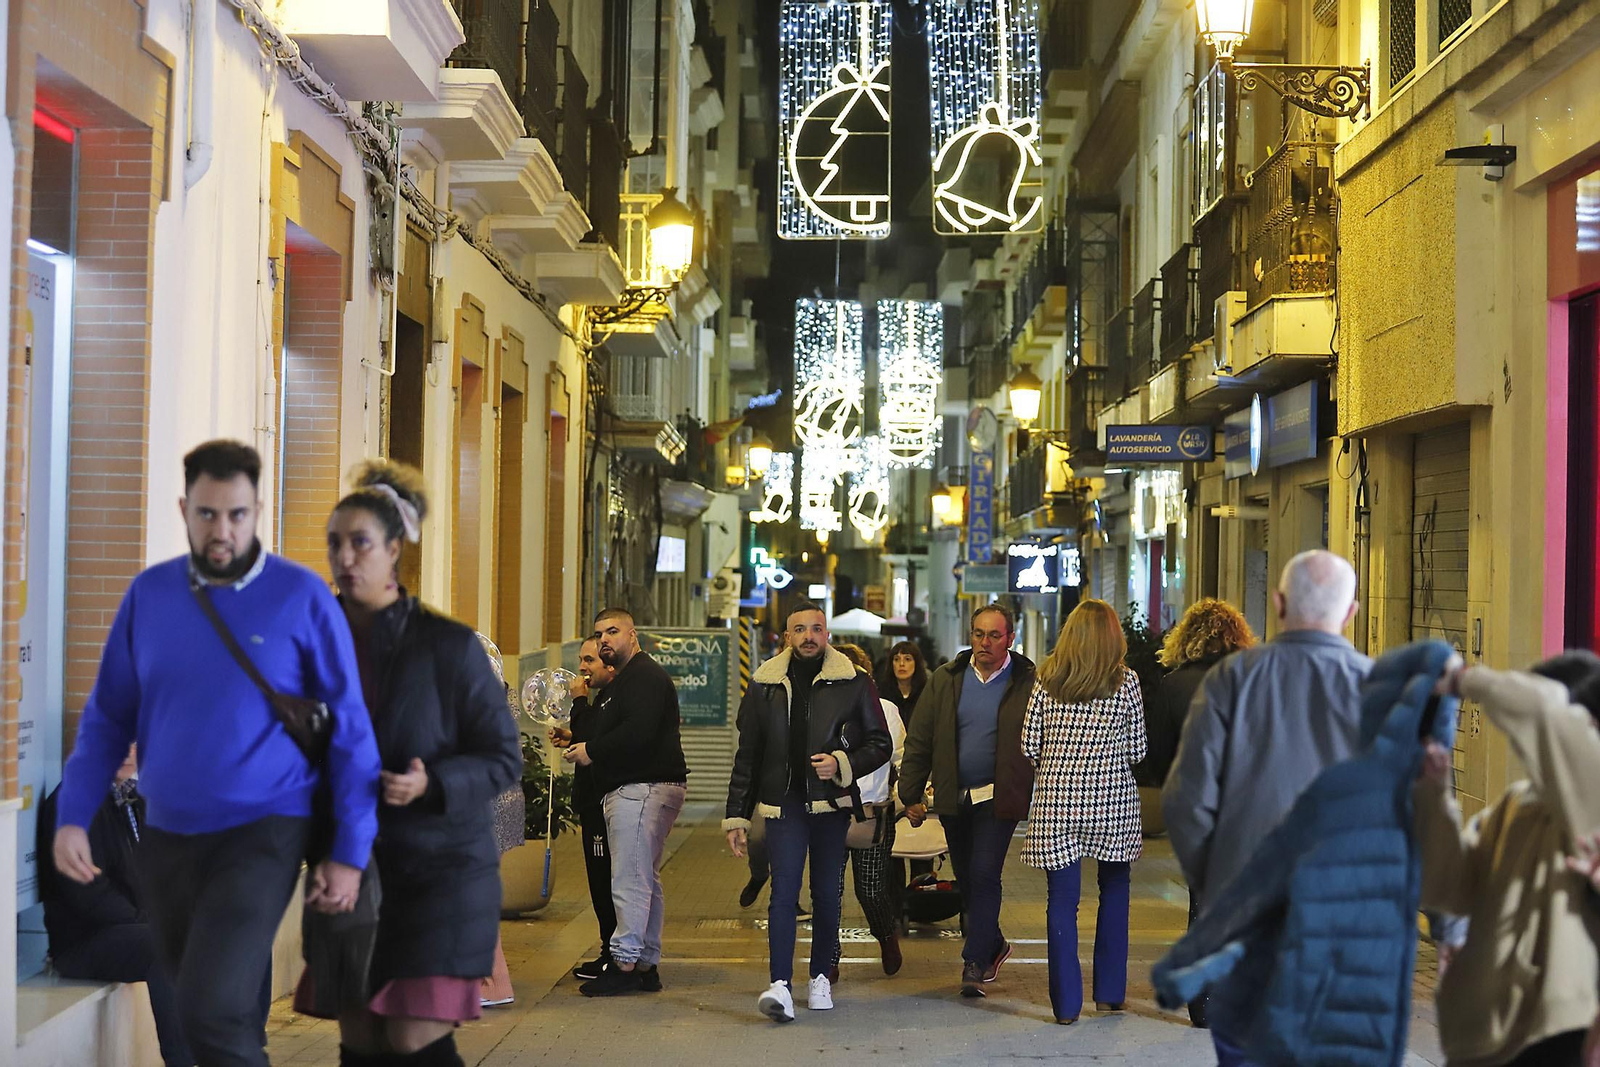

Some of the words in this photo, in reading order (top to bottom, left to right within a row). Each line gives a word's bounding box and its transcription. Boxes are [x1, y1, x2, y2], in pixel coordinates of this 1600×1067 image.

[1109, 432, 1162, 443] LAVANDERÍA
[1109, 446, 1172, 454] AUTOSERVICIO
[973, 454, 988, 560] GIRLADY
[659, 639, 722, 655] COCINA
